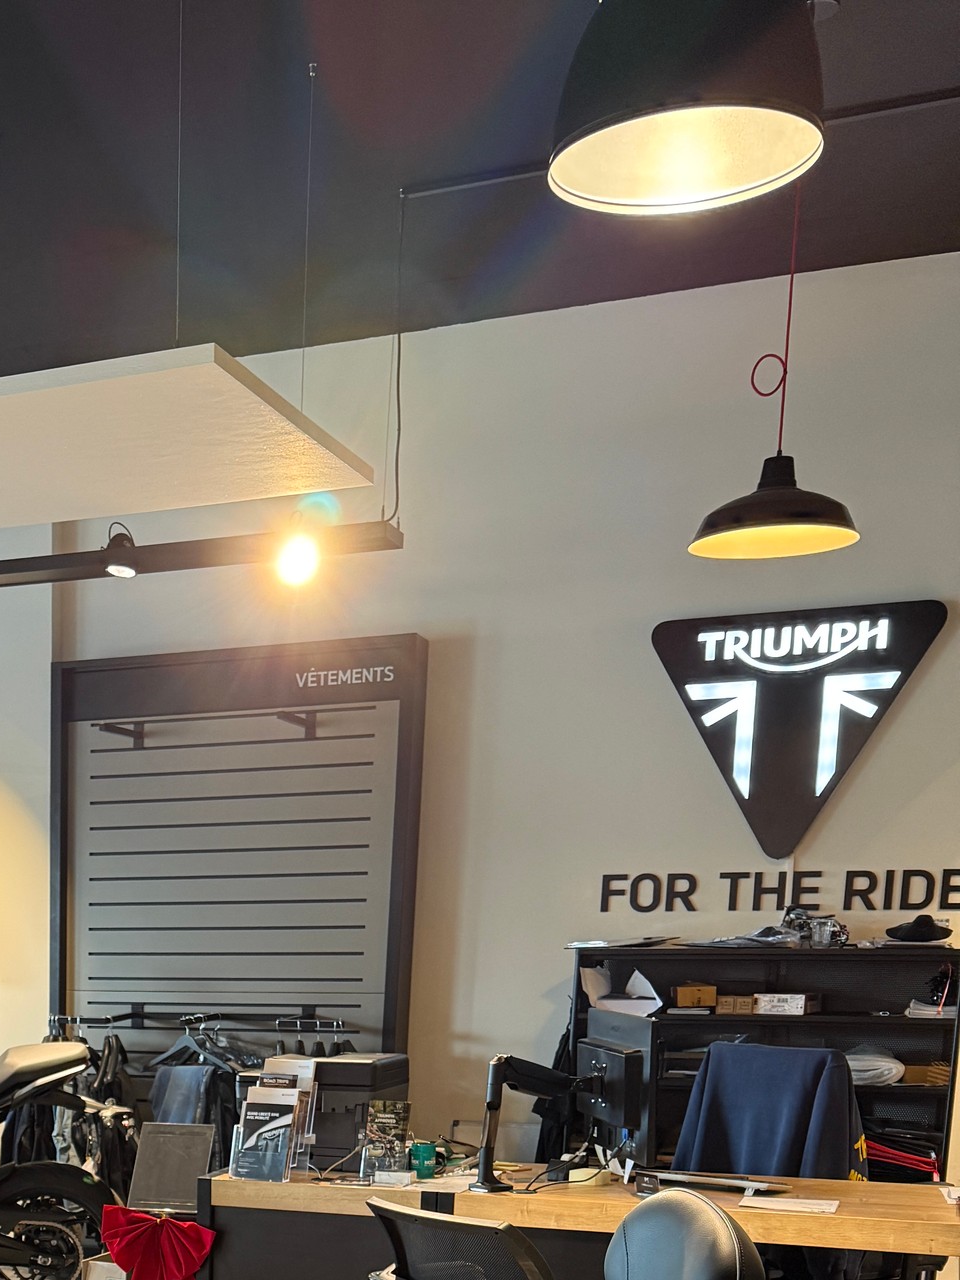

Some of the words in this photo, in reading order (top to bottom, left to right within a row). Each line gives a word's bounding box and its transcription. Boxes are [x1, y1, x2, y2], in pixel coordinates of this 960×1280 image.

[697, 618, 889, 672] TRIUMPH
[295, 666, 394, 688] VÊTEMENTS
[600, 873, 699, 913] FOR
[719, 870, 823, 912] THE
[843, 868, 960, 912] RIDE
